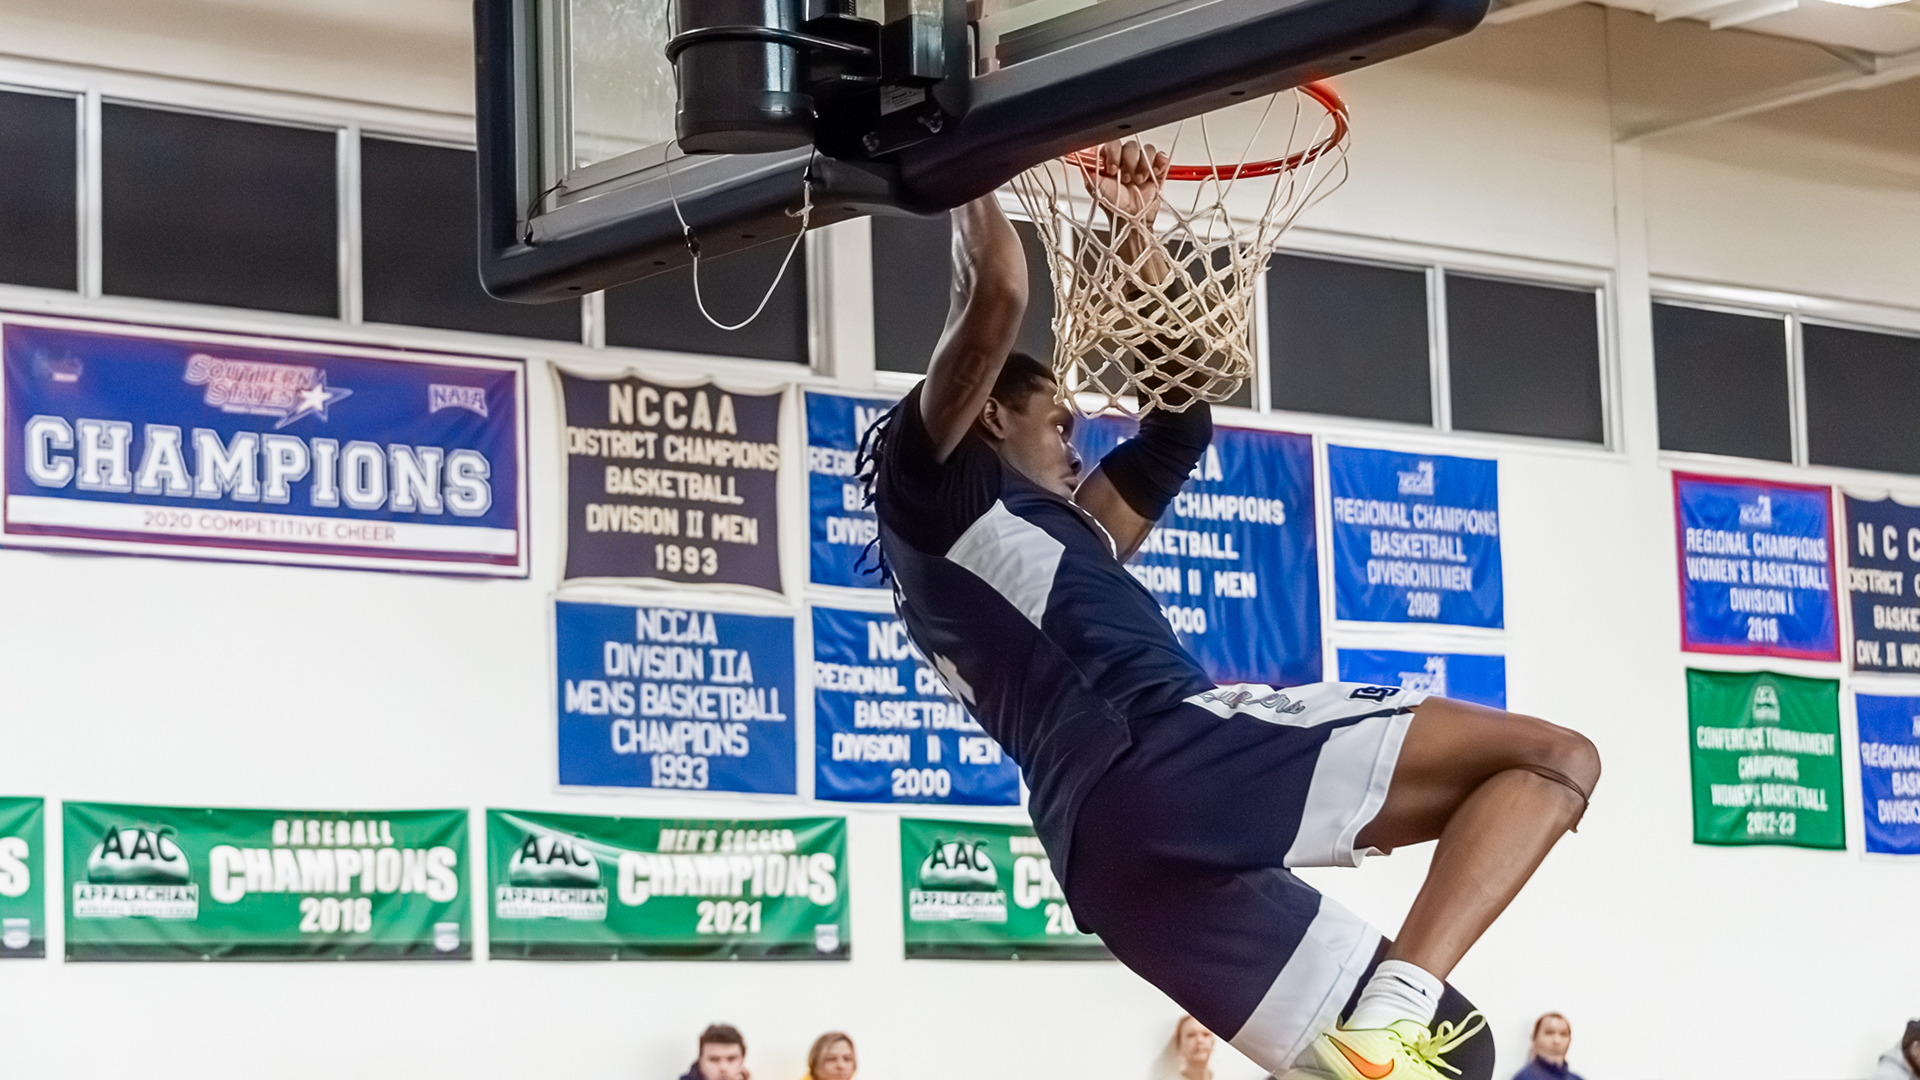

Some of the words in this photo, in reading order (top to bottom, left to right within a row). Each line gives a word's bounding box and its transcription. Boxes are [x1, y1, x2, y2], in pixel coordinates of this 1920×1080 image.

[608, 382, 738, 435] NCCAA
[24, 414, 492, 517] CHAMPIONS
[566, 426, 658, 460] DISTRICT
[663, 434, 779, 472] CHAMPIONS
[605, 465, 744, 505] BASKETBALL
[586, 504, 679, 536] DIVISION
[686, 510, 704, 538] II
[711, 513, 758, 545] MEN
[1174, 492, 1286, 525] CHAMPIONS
[1334, 497, 1411, 529] REGIONAL
[1413, 503, 1497, 536] CHAMPIONS
[144, 510, 192, 528] 2020
[199, 514, 328, 538] COMPETITIVE
[335, 523, 395, 542] CHEER
[655, 544, 718, 576] 1993
[1370, 530, 1467, 562] BASKETBALL
[1686, 527, 1751, 556] REGIONAL
[1753, 532, 1827, 563] CHAMPIONS
[1188, 568, 1202, 596] II
[1214, 570, 1257, 598] MEN
[1686, 557, 1750, 584] WOMEN'S
[1752, 560, 1829, 591] BASKETBALL
[1848, 567, 1903, 596] DISTRICT
[1730, 587, 1787, 614] DIVISION
[636, 608, 718, 645] NCCAA
[604, 641, 704, 680] DIVISION
[709, 648, 753, 684] IIA
[814, 661, 906, 694] REGIONAL
[565, 678, 635, 716] MENS
[640, 683, 787, 722] BASKETBALL
[611, 718, 749, 757] CHAMPIONS
[832, 733, 910, 762] DIVISION
[926, 734, 941, 763] II
[959, 736, 1001, 764] MEN
[650, 754, 709, 789] 1993
[891, 768, 950, 797] 2000
[1878, 799, 1920, 824] DIVISIO
[101, 825, 178, 862] AAC
[272, 819, 394, 846] BASEBALL
[520, 834, 590, 867] AAC
[930, 839, 988, 872] AAC
[208, 844, 458, 903] CHAMPIONS
[617, 851, 836, 906] CHAMPIONS
[696, 900, 762, 934] 2021
